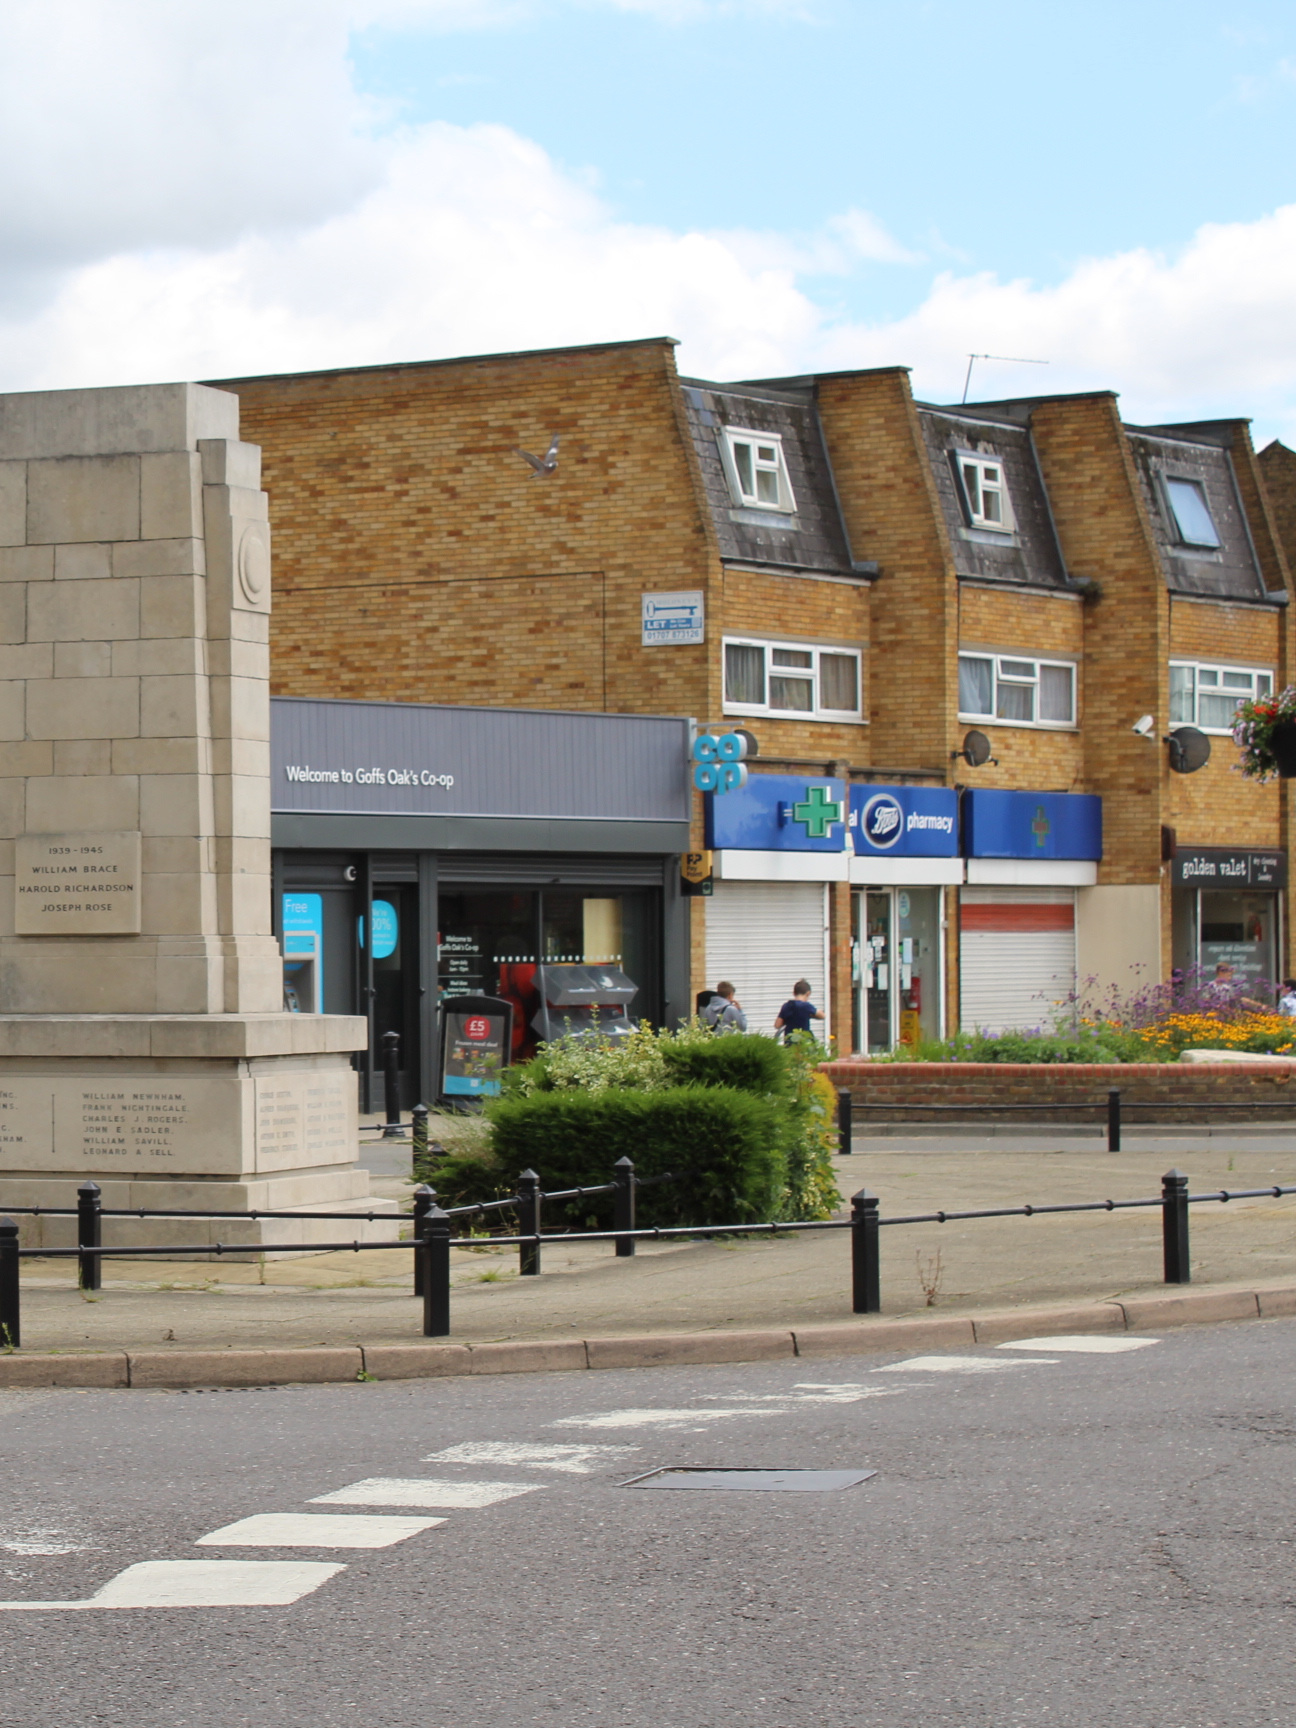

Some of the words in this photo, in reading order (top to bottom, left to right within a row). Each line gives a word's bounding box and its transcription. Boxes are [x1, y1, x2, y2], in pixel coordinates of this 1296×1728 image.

[647, 620, 666, 629] LET
[647, 631, 669, 639] 01707
[286, 766, 339, 782] Welcome
[340, 769, 353, 784] to
[355, 768, 386, 784] Goffs
[387, 769, 418, 786] Oak's
[420, 770, 454, 790] Co-op
[871, 806, 899, 834] Boots
[907, 811, 953, 834] pharmacy
[1182, 857, 1216, 879] golden
[1220, 858, 1246, 876] valet
[285, 899, 308, 912] Free
[469, 1020, 485, 1031] £5
